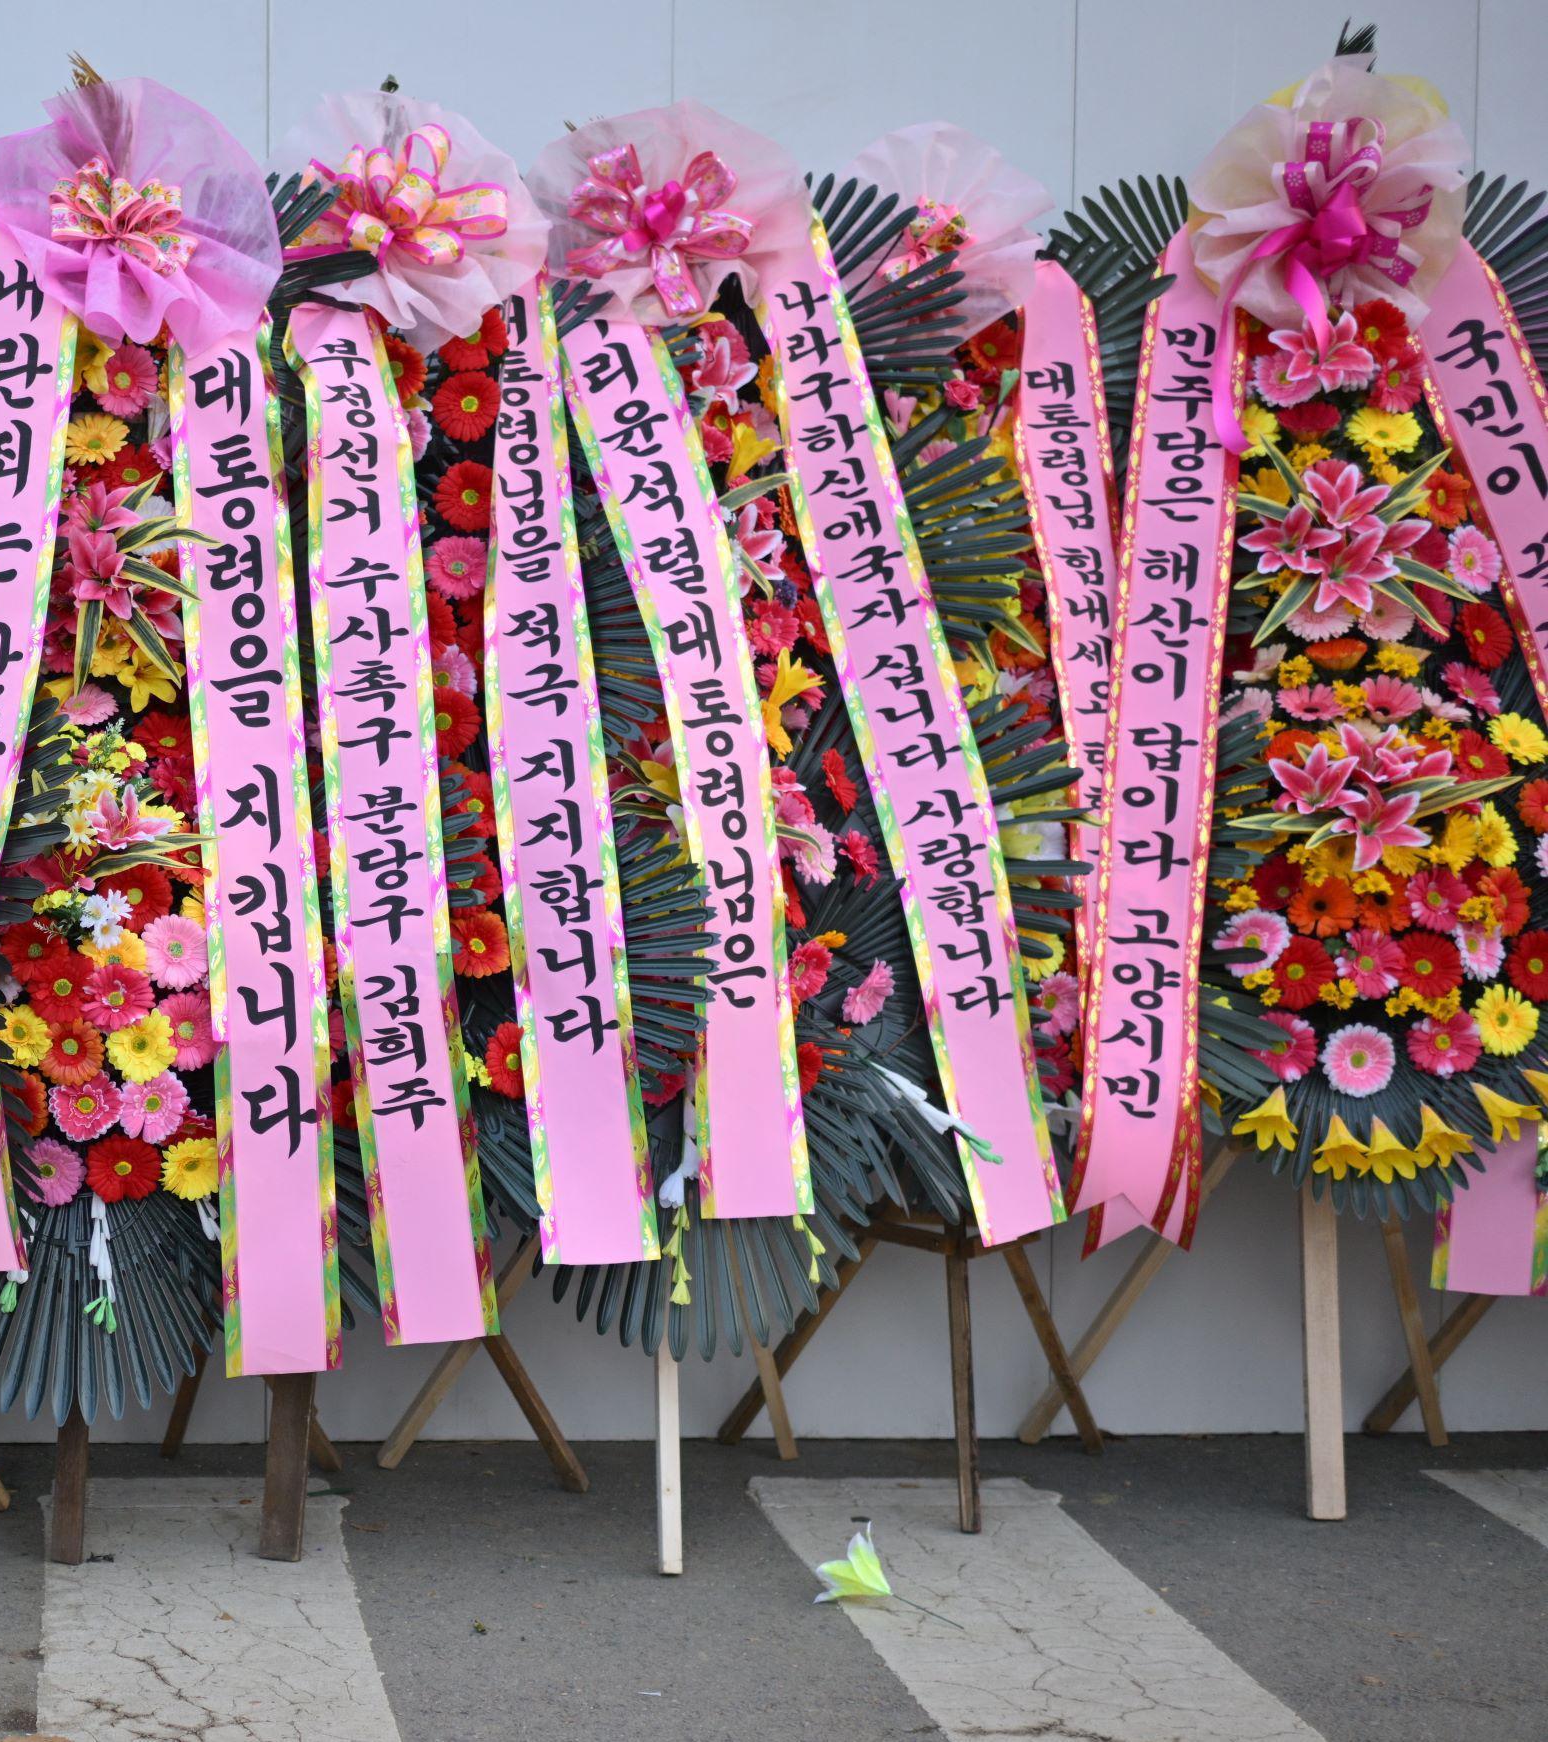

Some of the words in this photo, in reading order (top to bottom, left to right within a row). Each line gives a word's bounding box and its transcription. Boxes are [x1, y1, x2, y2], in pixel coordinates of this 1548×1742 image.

[307, 338, 381, 536] 부정선거
[1024, 361, 1095, 531] 대통령님
[1143, 322, 1222, 523] 민주당은
[1434, 318, 1548, 500] 국민이
[189, 348, 282, 728] 대통령을
[1129, 543, 1209, 701] 해산이
[325, 557, 412, 766] 수사촉구
[503, 603, 580, 718] 적극
[344, 785, 423, 945] 분당구
[512, 739, 620, 1054] 지지합니다
[1118, 721, 1198, 882] 답이다
[220, 764, 317, 1159] 지킵니다
[902, 788, 1013, 1018] 사랑합니다
[363, 964, 447, 1132] 김희주
[1101, 906, 1181, 1119] 고양시민
